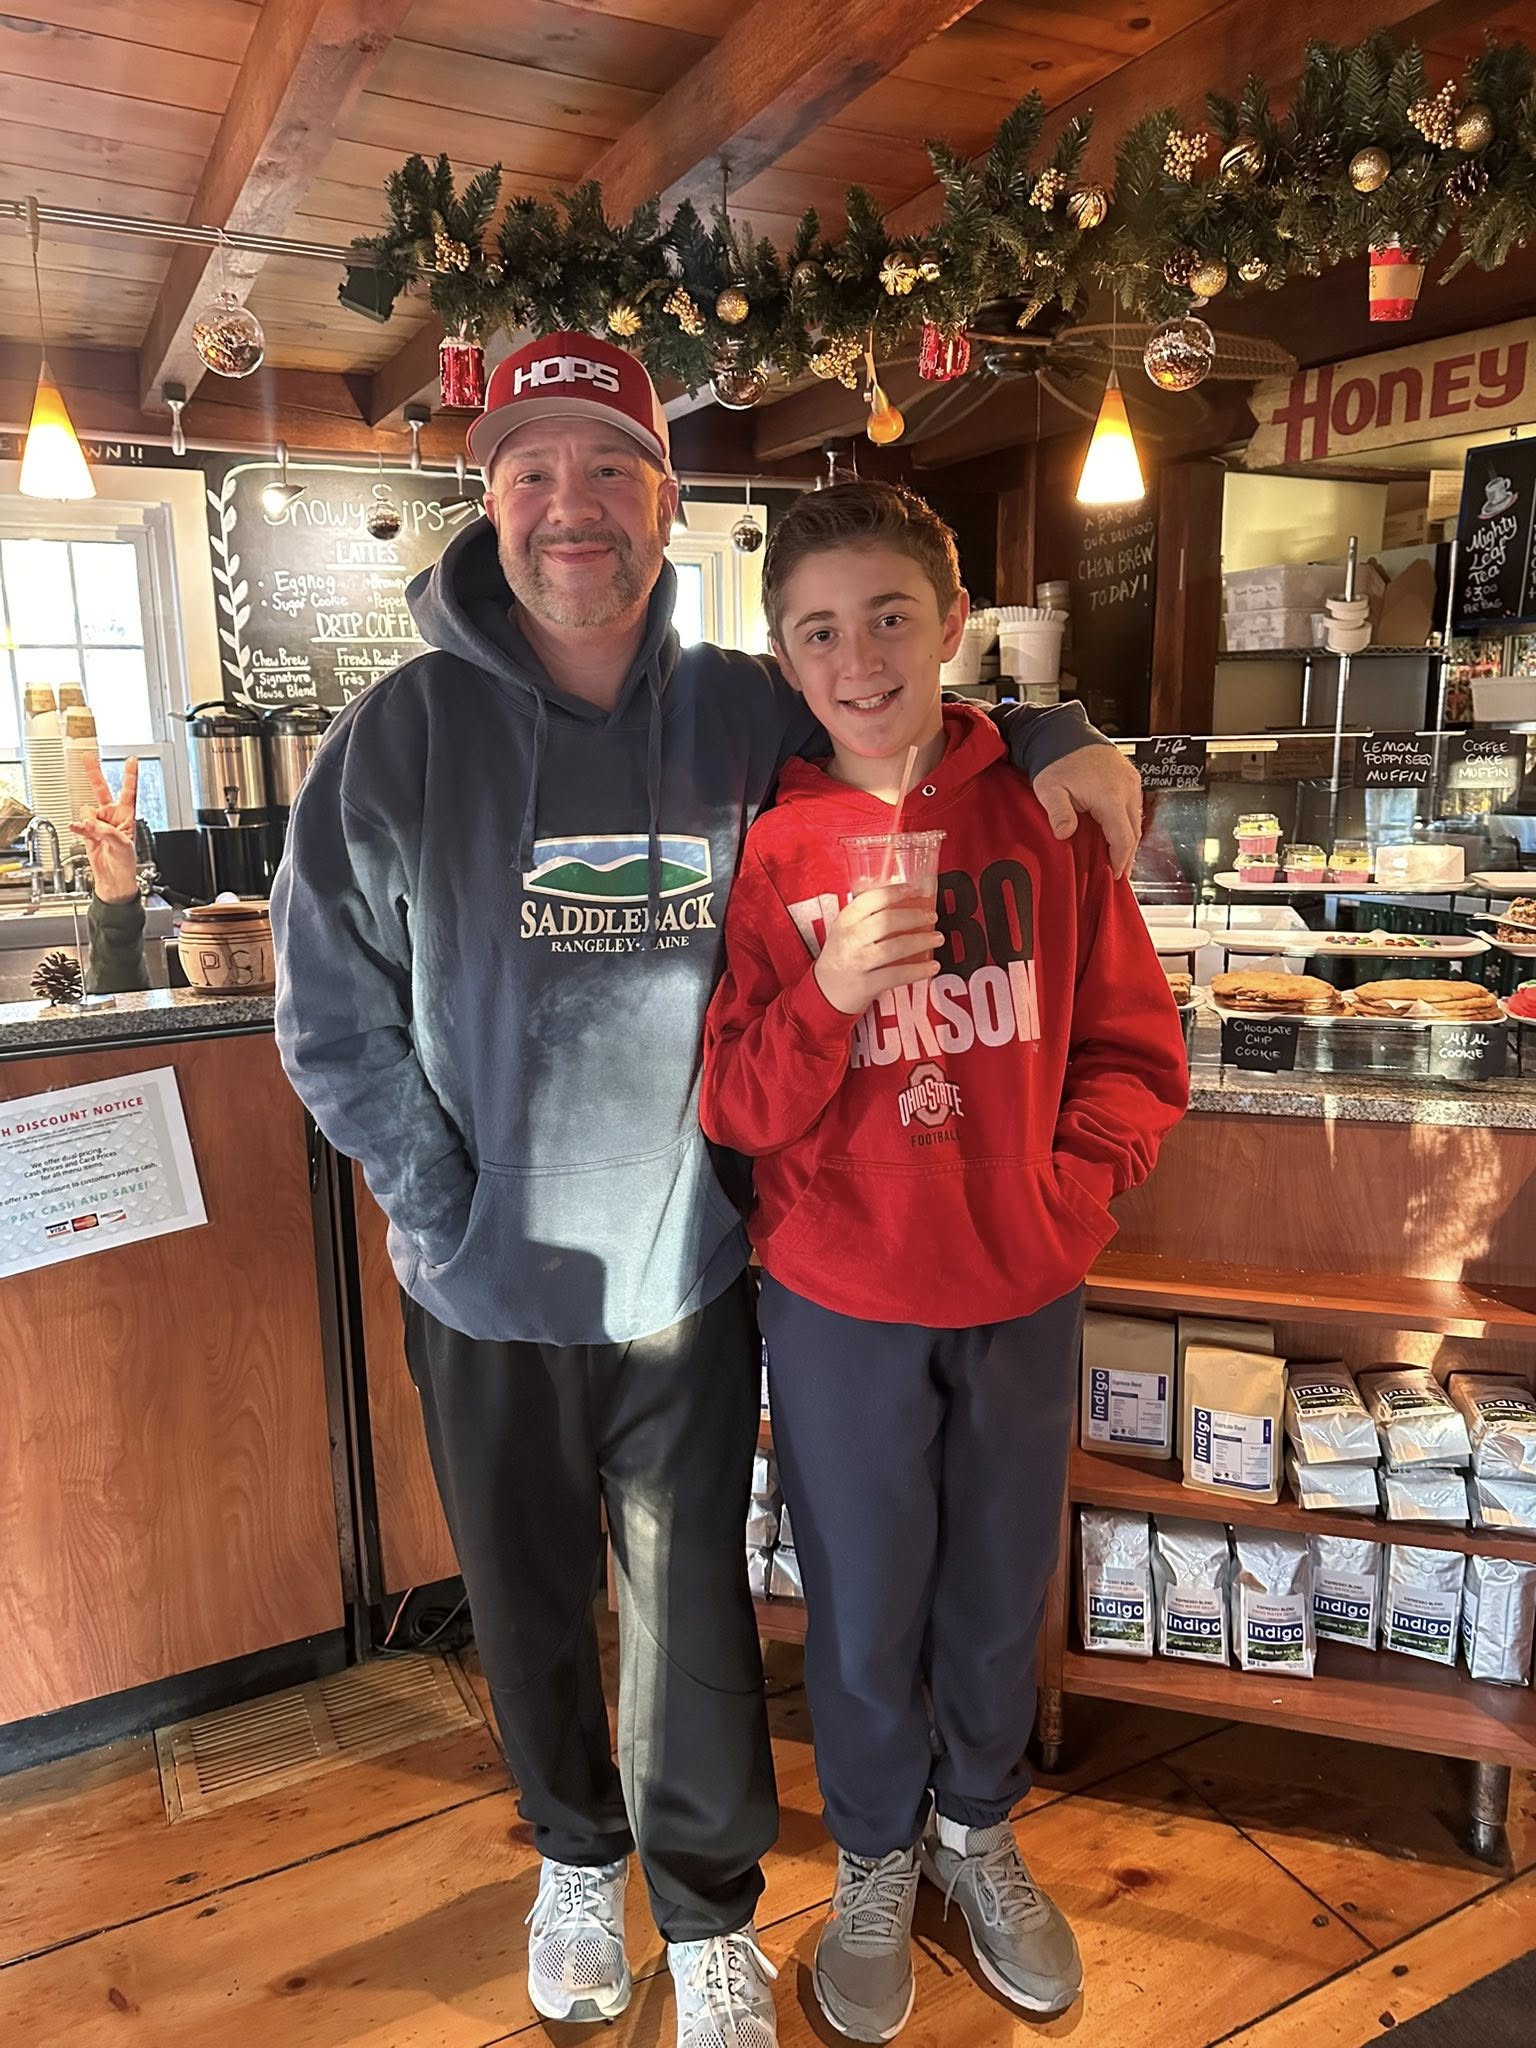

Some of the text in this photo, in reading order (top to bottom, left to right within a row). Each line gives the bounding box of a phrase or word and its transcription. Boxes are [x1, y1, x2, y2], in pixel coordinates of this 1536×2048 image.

[514, 356, 620, 396] HOPS
[1466, 515, 1517, 552] Mighty
[336, 541, 399, 564] LATTES
[1078, 536, 1155, 580] CHEW BREW
[1469, 537, 1506, 570] Leaf
[274, 571, 336, 595] Eggnog
[1468, 565, 1500, 585] Tea
[272, 592, 307, 618] Sugar
[310, 592, 349, 608] Cookie
[316, 612, 423, 638] DRIP COFF
[279, 647, 309, 666] Brew
[336, 648, 372, 666] French
[256, 682, 317, 699] House Blend
[259, 673, 311, 689] Signature
[1362, 741, 1419, 753] LEMON
[1463, 739, 1509, 754] COFFEE
[1161, 755, 1177, 765] OR
[1465, 754, 1503, 766] CAKE
[1140, 763, 1204, 777] RASPBERRY
[1366, 769, 1427, 782] MUFFIN
[1458, 766, 1509, 779] MUFFIN
[1142, 776, 1200, 788] EMON BAR
[520, 892, 717, 939] SADDLEBACK
[641, 936, 690, 951] AINE
[851, 959, 1040, 1069] ACKSON
[1233, 1020, 1292, 1035] CHOCOLATE
[1245, 1034, 1272, 1045] CHIP
[1235, 1046, 1280, 1060] COOKIE
[1439, 1048, 1484, 1060] COOKIE
[16, 1109, 88, 1134] DISCOUNT
[93, 1097, 144, 1116] NOTICE
[911, 1129, 961, 1147] FOOTBALL
[41, 1183, 71, 1196] discount
[80, 1172, 116, 1186] customers
[117, 1166, 139, 1178] paying
[10, 1181, 149, 1224] PAY CASH AND SAVE!
[1093, 1371, 1108, 1419] Indigo
[1195, 1411, 1210, 1461] Indigo
[1091, 1599, 1143, 1618] Indigo
[1315, 1597, 1369, 1617] Indigo
[1169, 1615, 1220, 1634] Indigo
[1249, 1623, 1302, 1641] Indigo
[1394, 1613, 1450, 1634] Indigo
